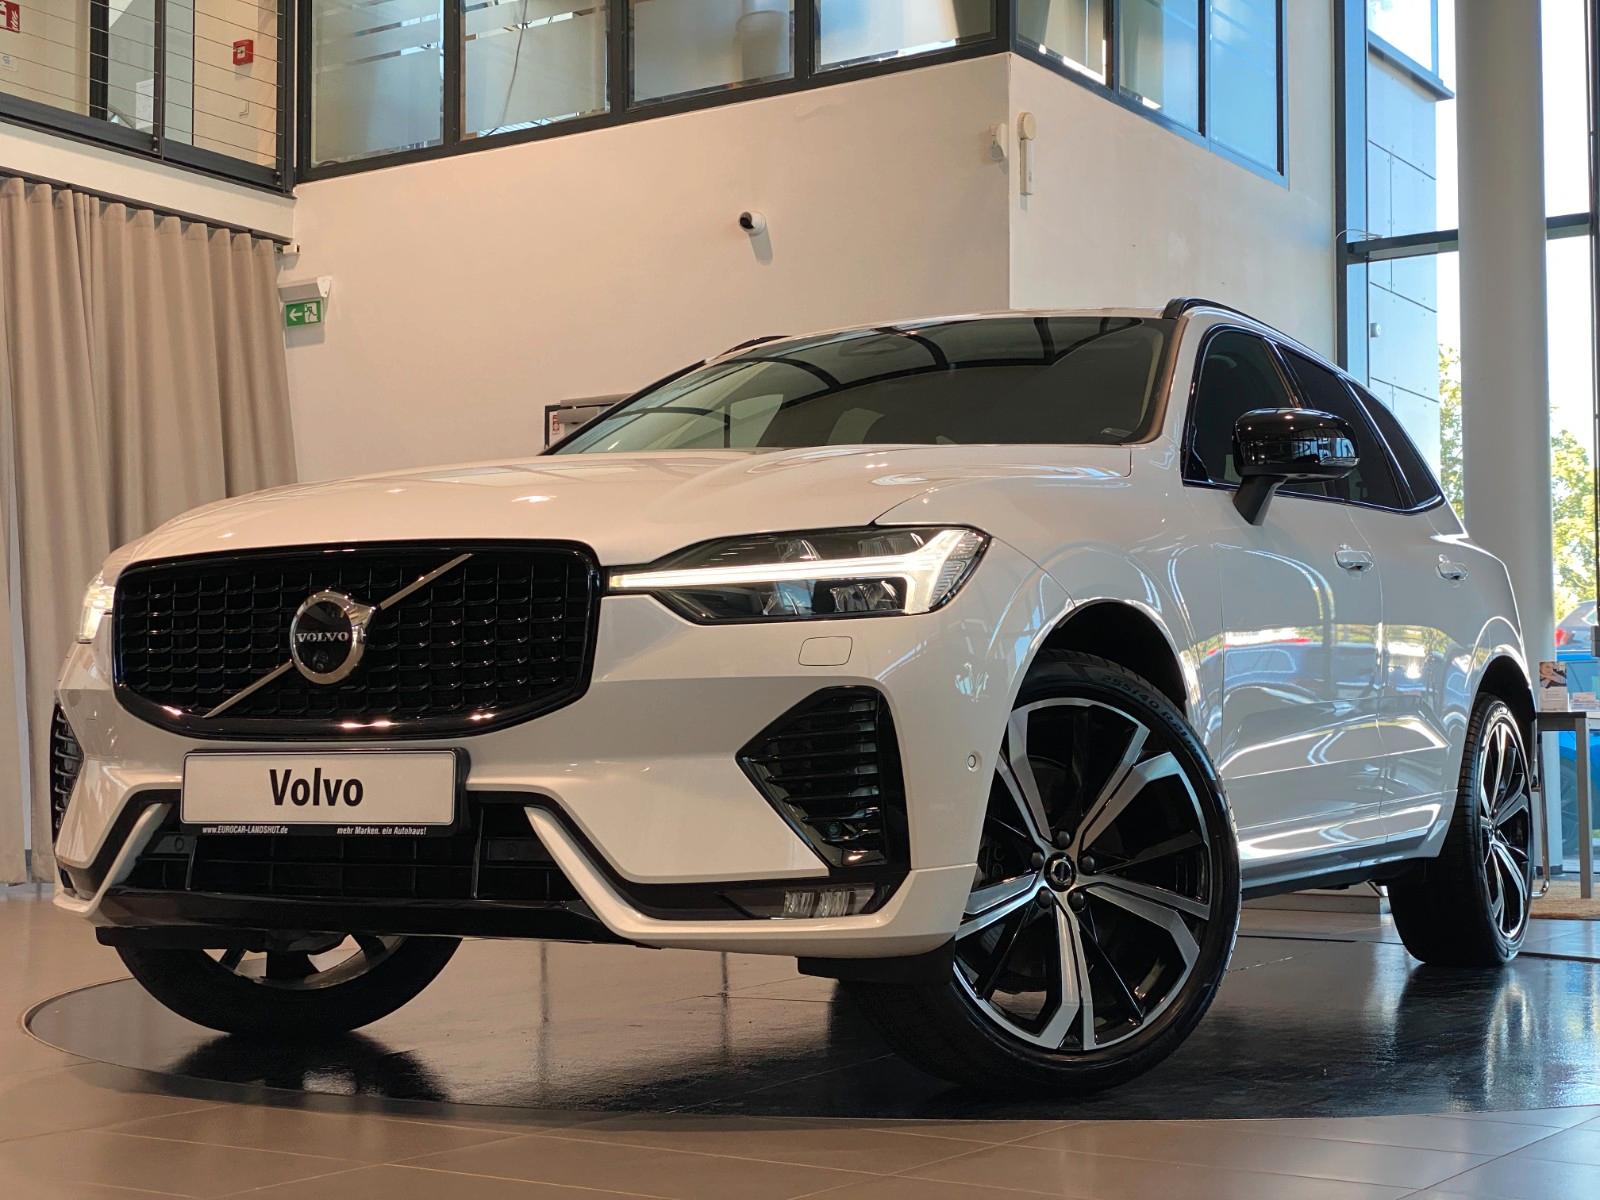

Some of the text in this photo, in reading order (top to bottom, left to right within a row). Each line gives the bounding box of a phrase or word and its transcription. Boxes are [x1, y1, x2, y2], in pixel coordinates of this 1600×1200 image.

[296, 631, 350, 643] VOLVO
[269, 767, 364, 807] Volvo
[202, 825, 289, 834] www.EUROCAR-LANDSHUT.de
[336, 826, 354, 835] mehr
[381, 826, 393, 835] ein
[393, 826, 427, 836] Autohaus!
